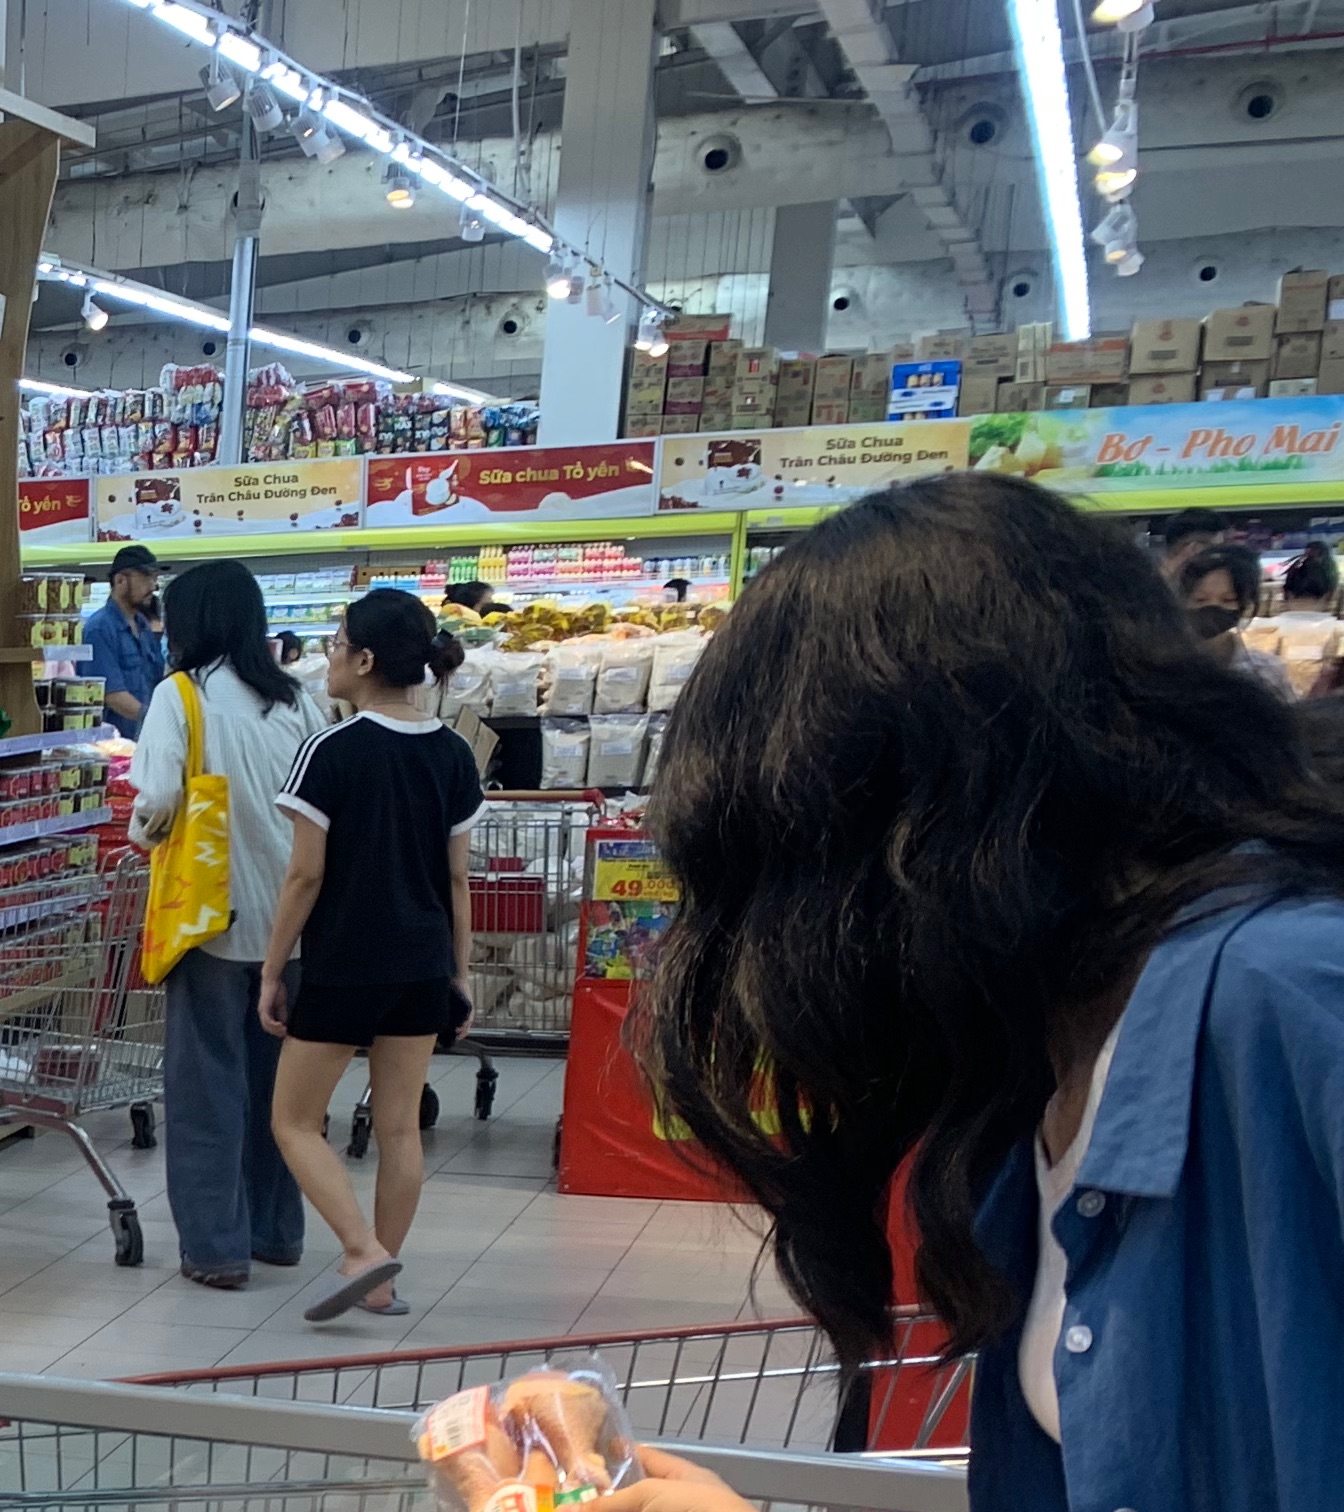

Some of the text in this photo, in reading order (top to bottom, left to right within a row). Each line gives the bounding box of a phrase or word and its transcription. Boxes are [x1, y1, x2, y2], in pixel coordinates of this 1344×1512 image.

[825, 435, 903, 451] Sữa Chua
[1096, 420, 1342, 464] Bơ Pho Mai
[779, 446, 949, 470] Trân Châu Đường Đen
[233, 472, 299, 487] Sữa Chua
[479, 457, 620, 486] Sữa chua Tổ yến
[196, 483, 338, 504] Trân Châu Đường Đen
[36, 496, 61, 514] yến
